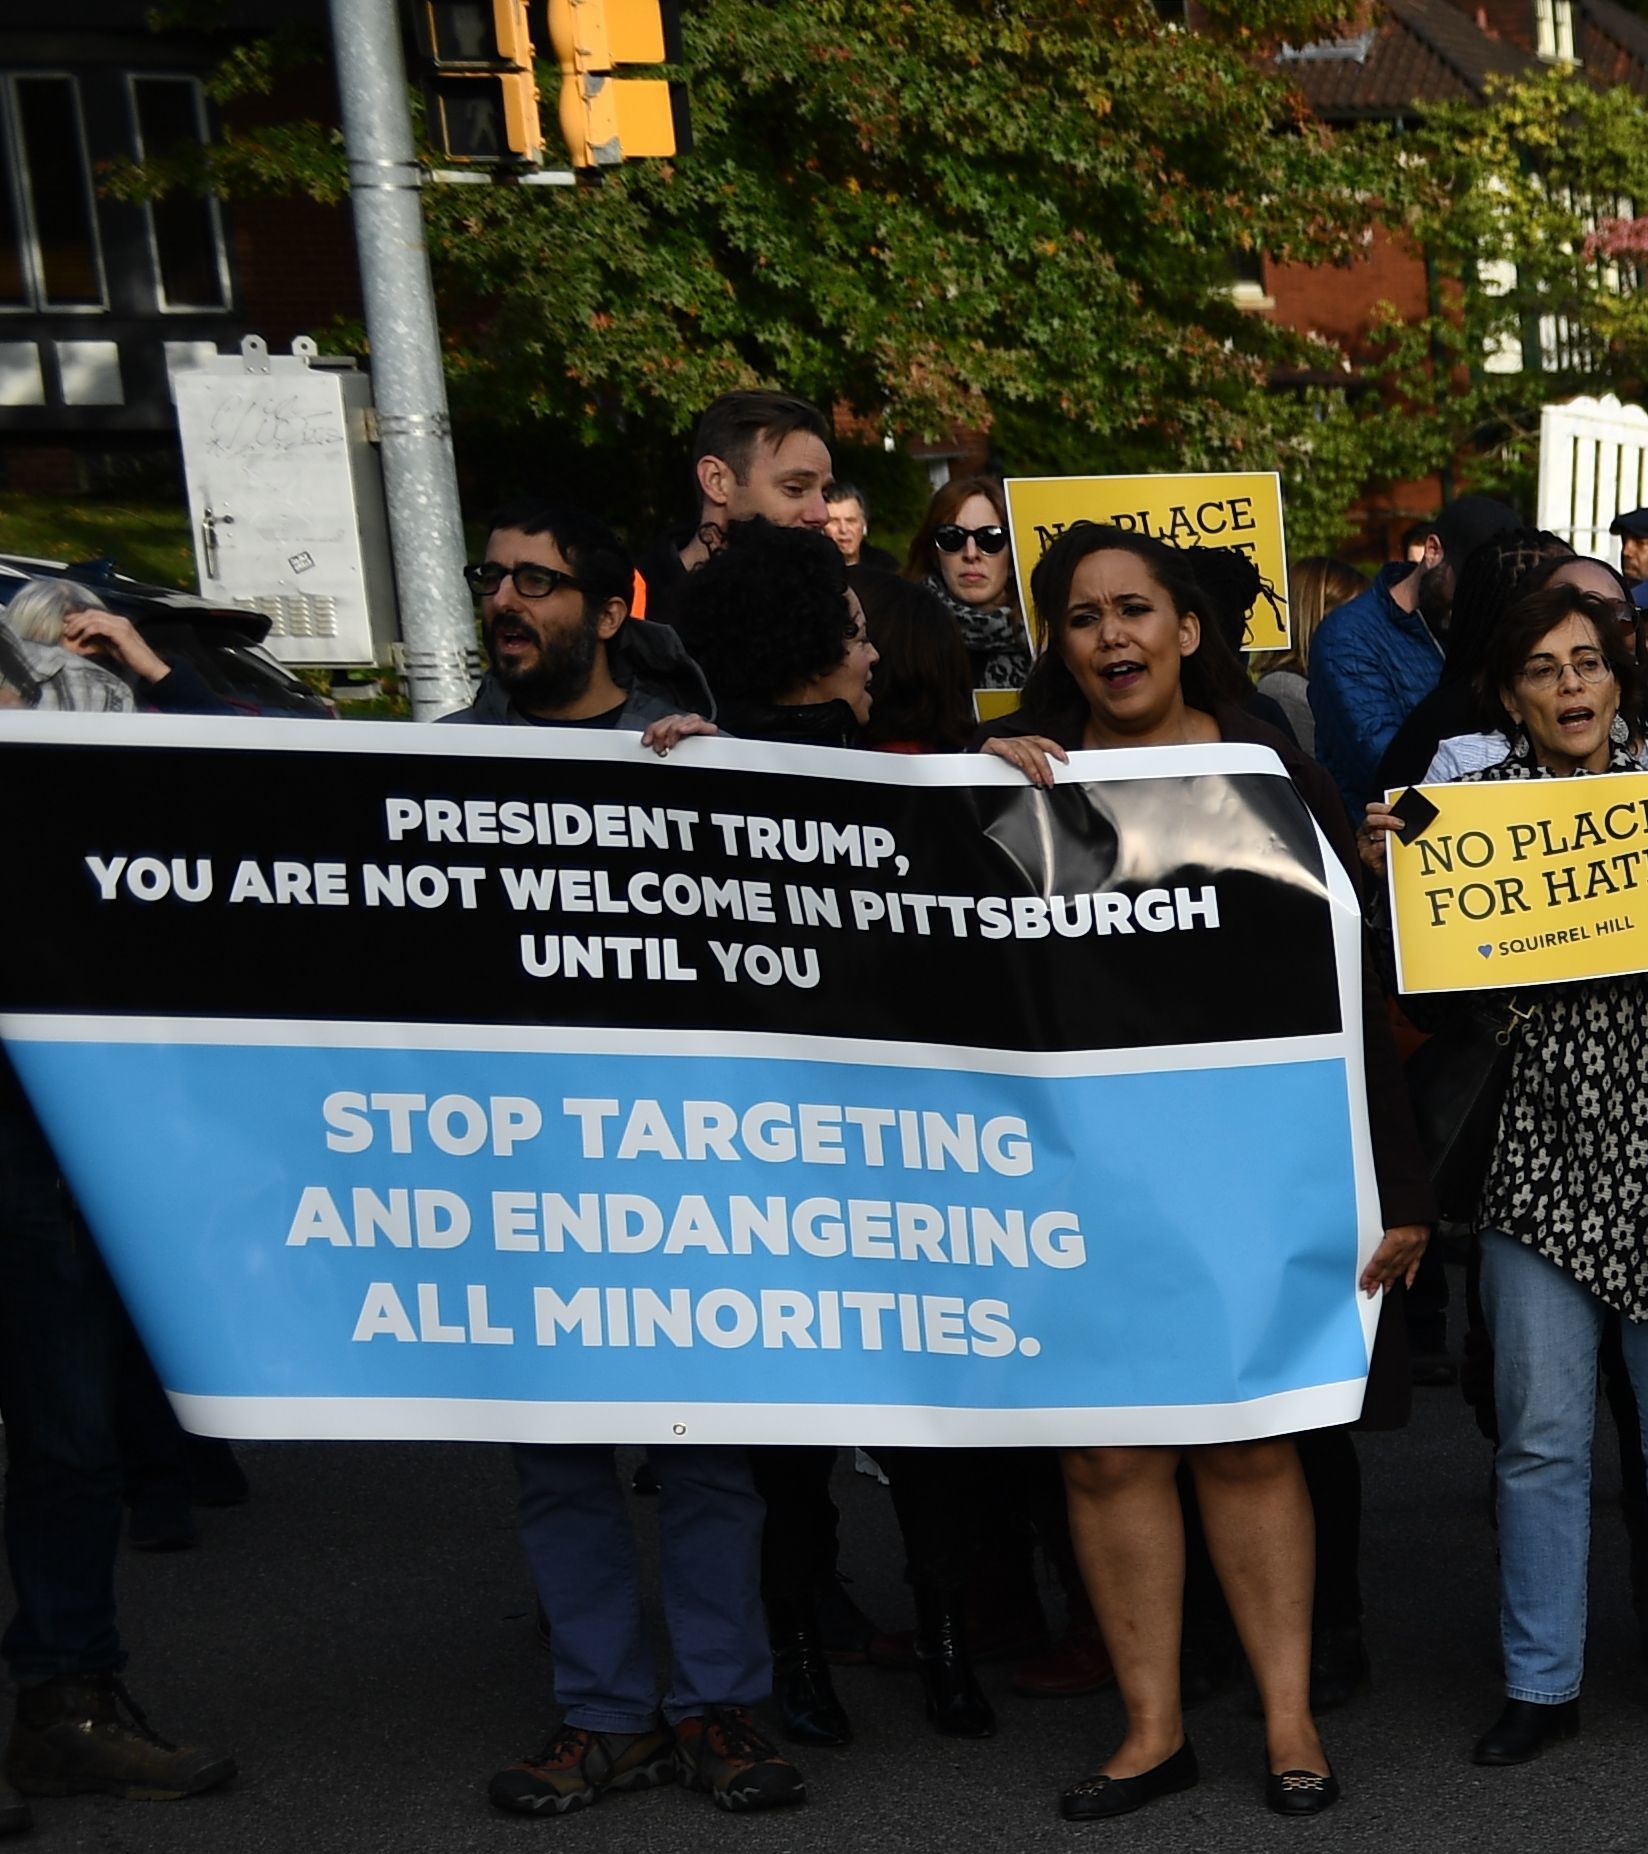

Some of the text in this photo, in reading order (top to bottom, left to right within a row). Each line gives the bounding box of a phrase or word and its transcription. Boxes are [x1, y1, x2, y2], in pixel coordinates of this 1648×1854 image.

[385, 797, 910, 877] PRESIDENT TRUMP,
[1415, 830, 1495, 878] NO
[84, 856, 1222, 940] YOU ARE NOT WELCOME IN PITTSBURGH
[1424, 878, 1532, 928] FOR
[1499, 915, 1635, 956] SQUIRREL HILL
[520, 934, 821, 989] UNTIL YOU
[322, 1090, 1034, 1177] STOP TARGETING
[285, 1186, 1087, 1269] AND ENDANGERING
[351, 1281, 1041, 1358] ALL MINORITIES.
